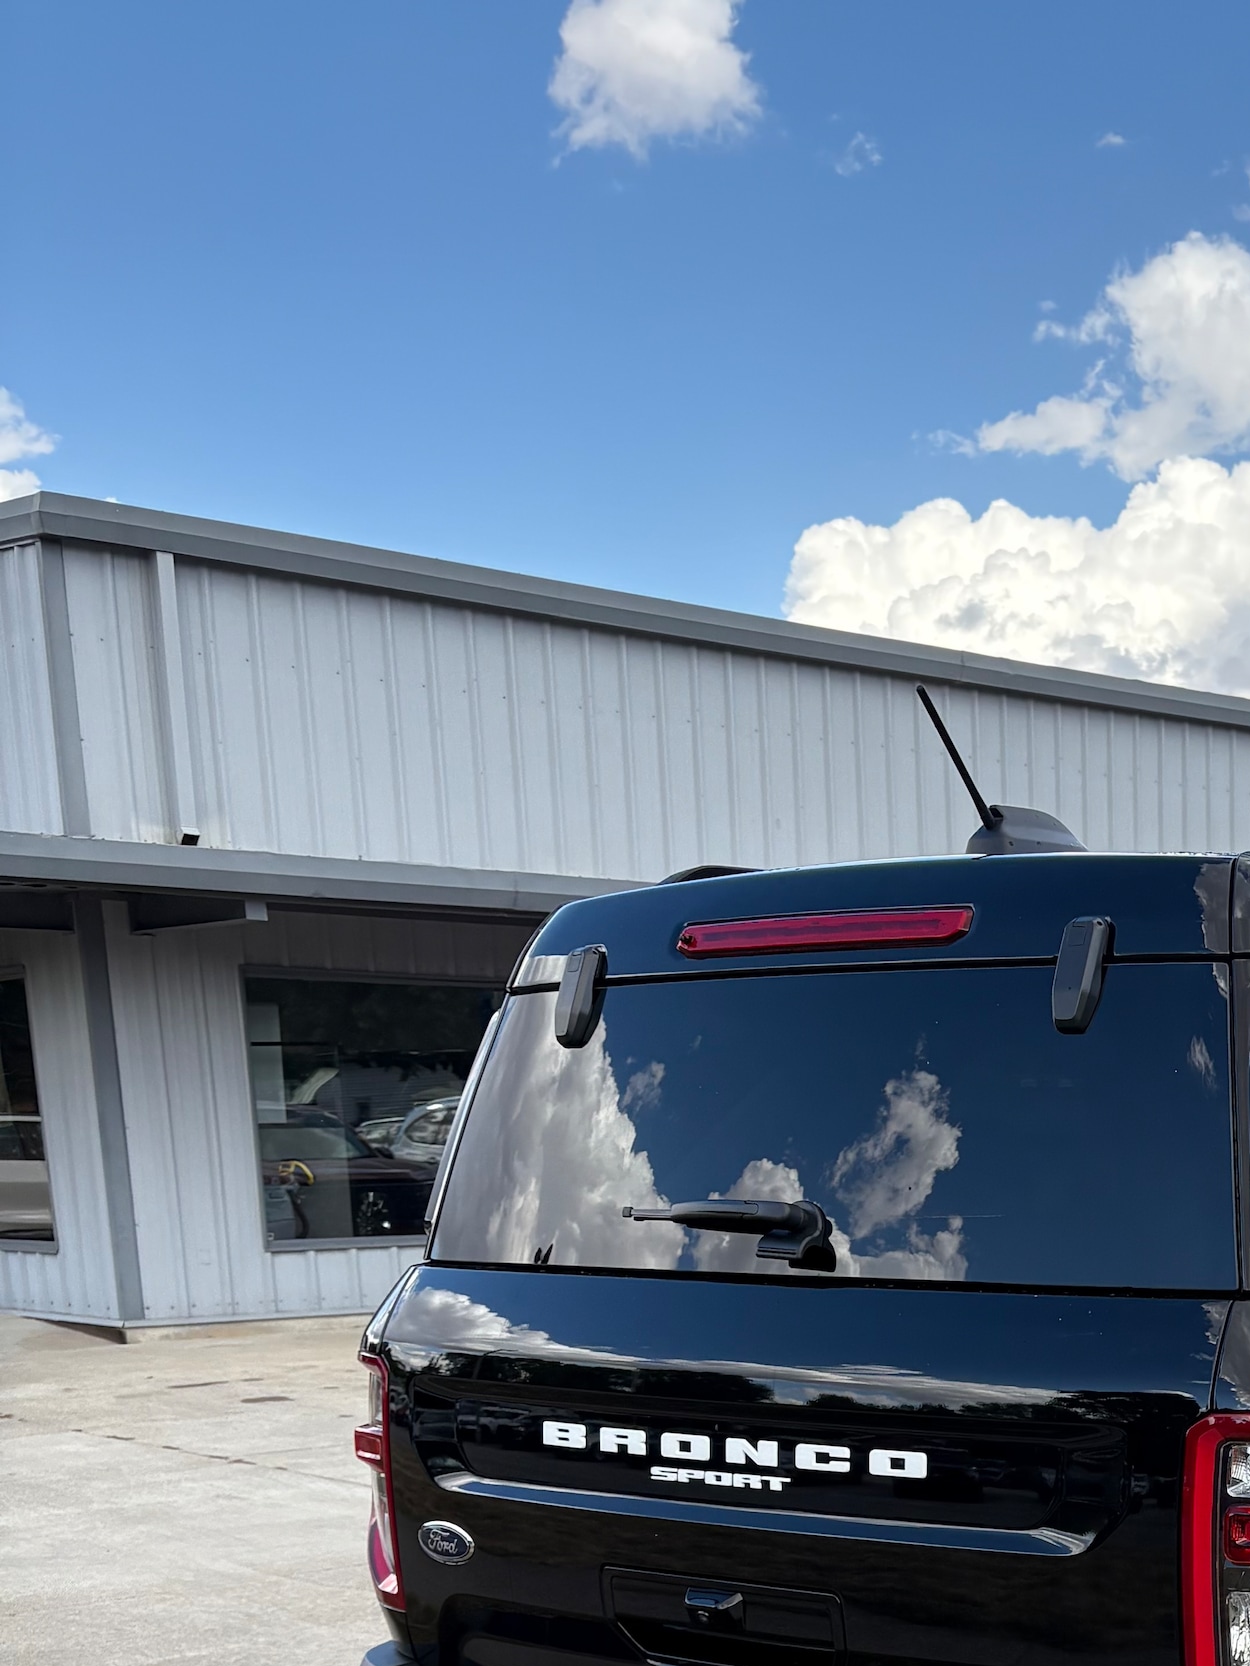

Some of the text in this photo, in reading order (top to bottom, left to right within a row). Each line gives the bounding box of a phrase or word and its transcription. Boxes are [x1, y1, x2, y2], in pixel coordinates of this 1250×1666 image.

[542, 1420, 928, 1479] BRONCO
[650, 1466, 791, 1491] SPORT
[428, 1529, 458, 1554] Ford
